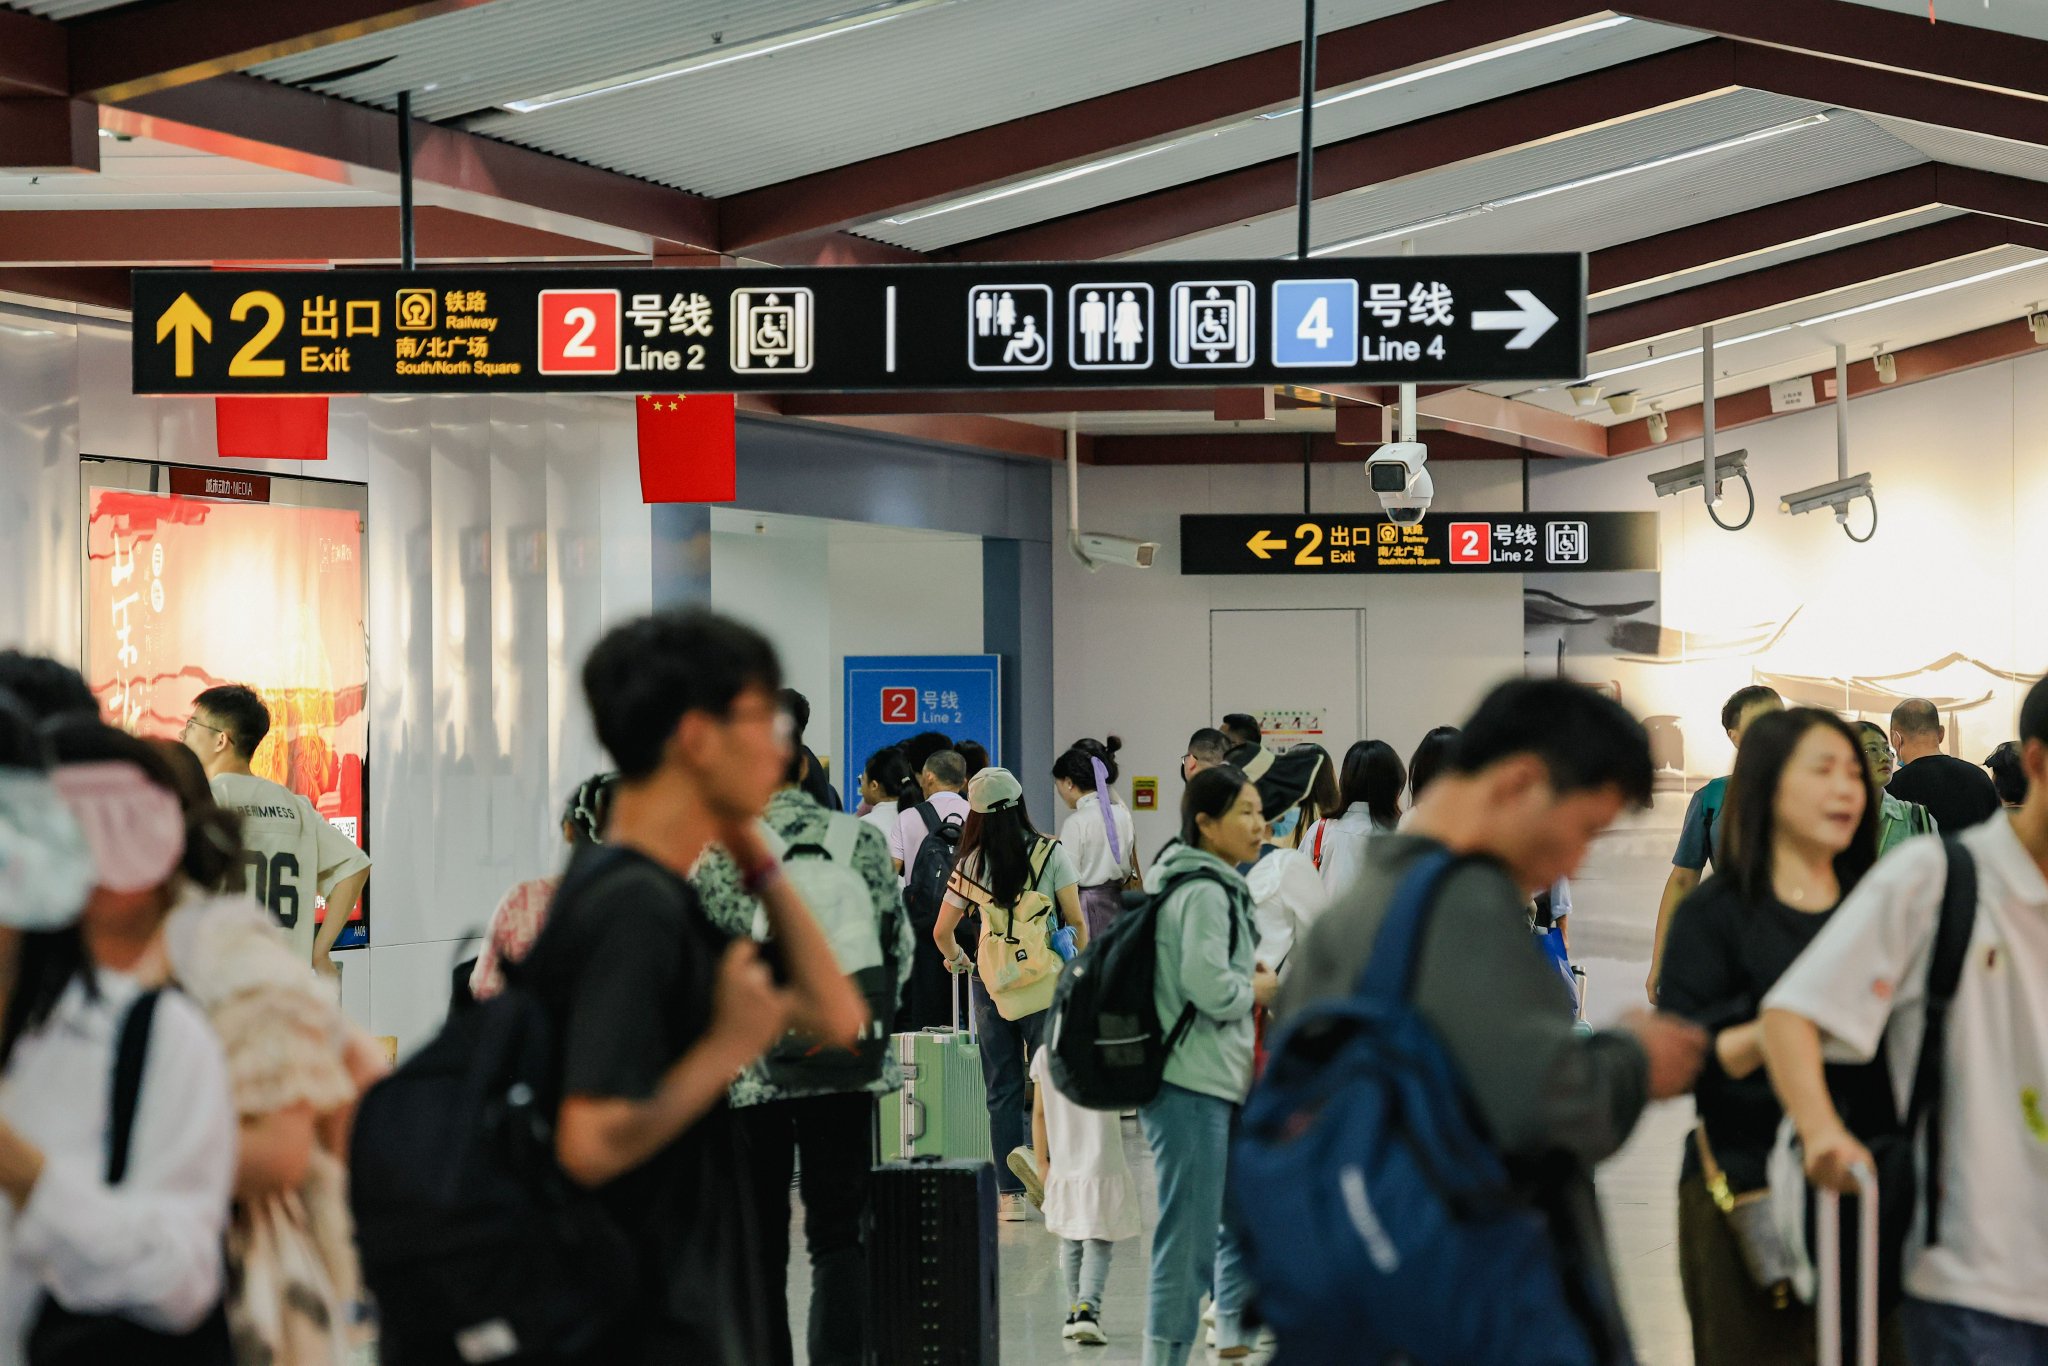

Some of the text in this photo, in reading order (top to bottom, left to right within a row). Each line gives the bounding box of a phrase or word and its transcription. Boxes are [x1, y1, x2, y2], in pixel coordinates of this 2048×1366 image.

[445, 290, 487, 312] 铁路
[301, 296, 381, 339] 出口
[446, 315, 498, 332] Railway
[562, 293, 714, 358] 2 号线
[1296, 281, 1455, 349] 4 号线
[228, 290, 286, 377] 2
[301, 346, 351, 372] Exit
[396, 336, 489, 358] 南/北广场
[625, 344, 706, 371] Line 2
[1363, 334, 1446, 362] Line 4
[396, 360, 521, 377] South/North Square
[1294, 523, 1324, 565] 2
[1330, 525, 1371, 546] 出口
[1402, 535, 1429, 545] Railway
[1461, 523, 1538, 556] 2 号线
[1330, 549, 1356, 563] Exit
[1417, 557, 1441, 567] Square
[1493, 548, 1534, 563] Line 2
[891, 690, 959, 718] 2 号线
[922, 711, 962, 724] Line 2
